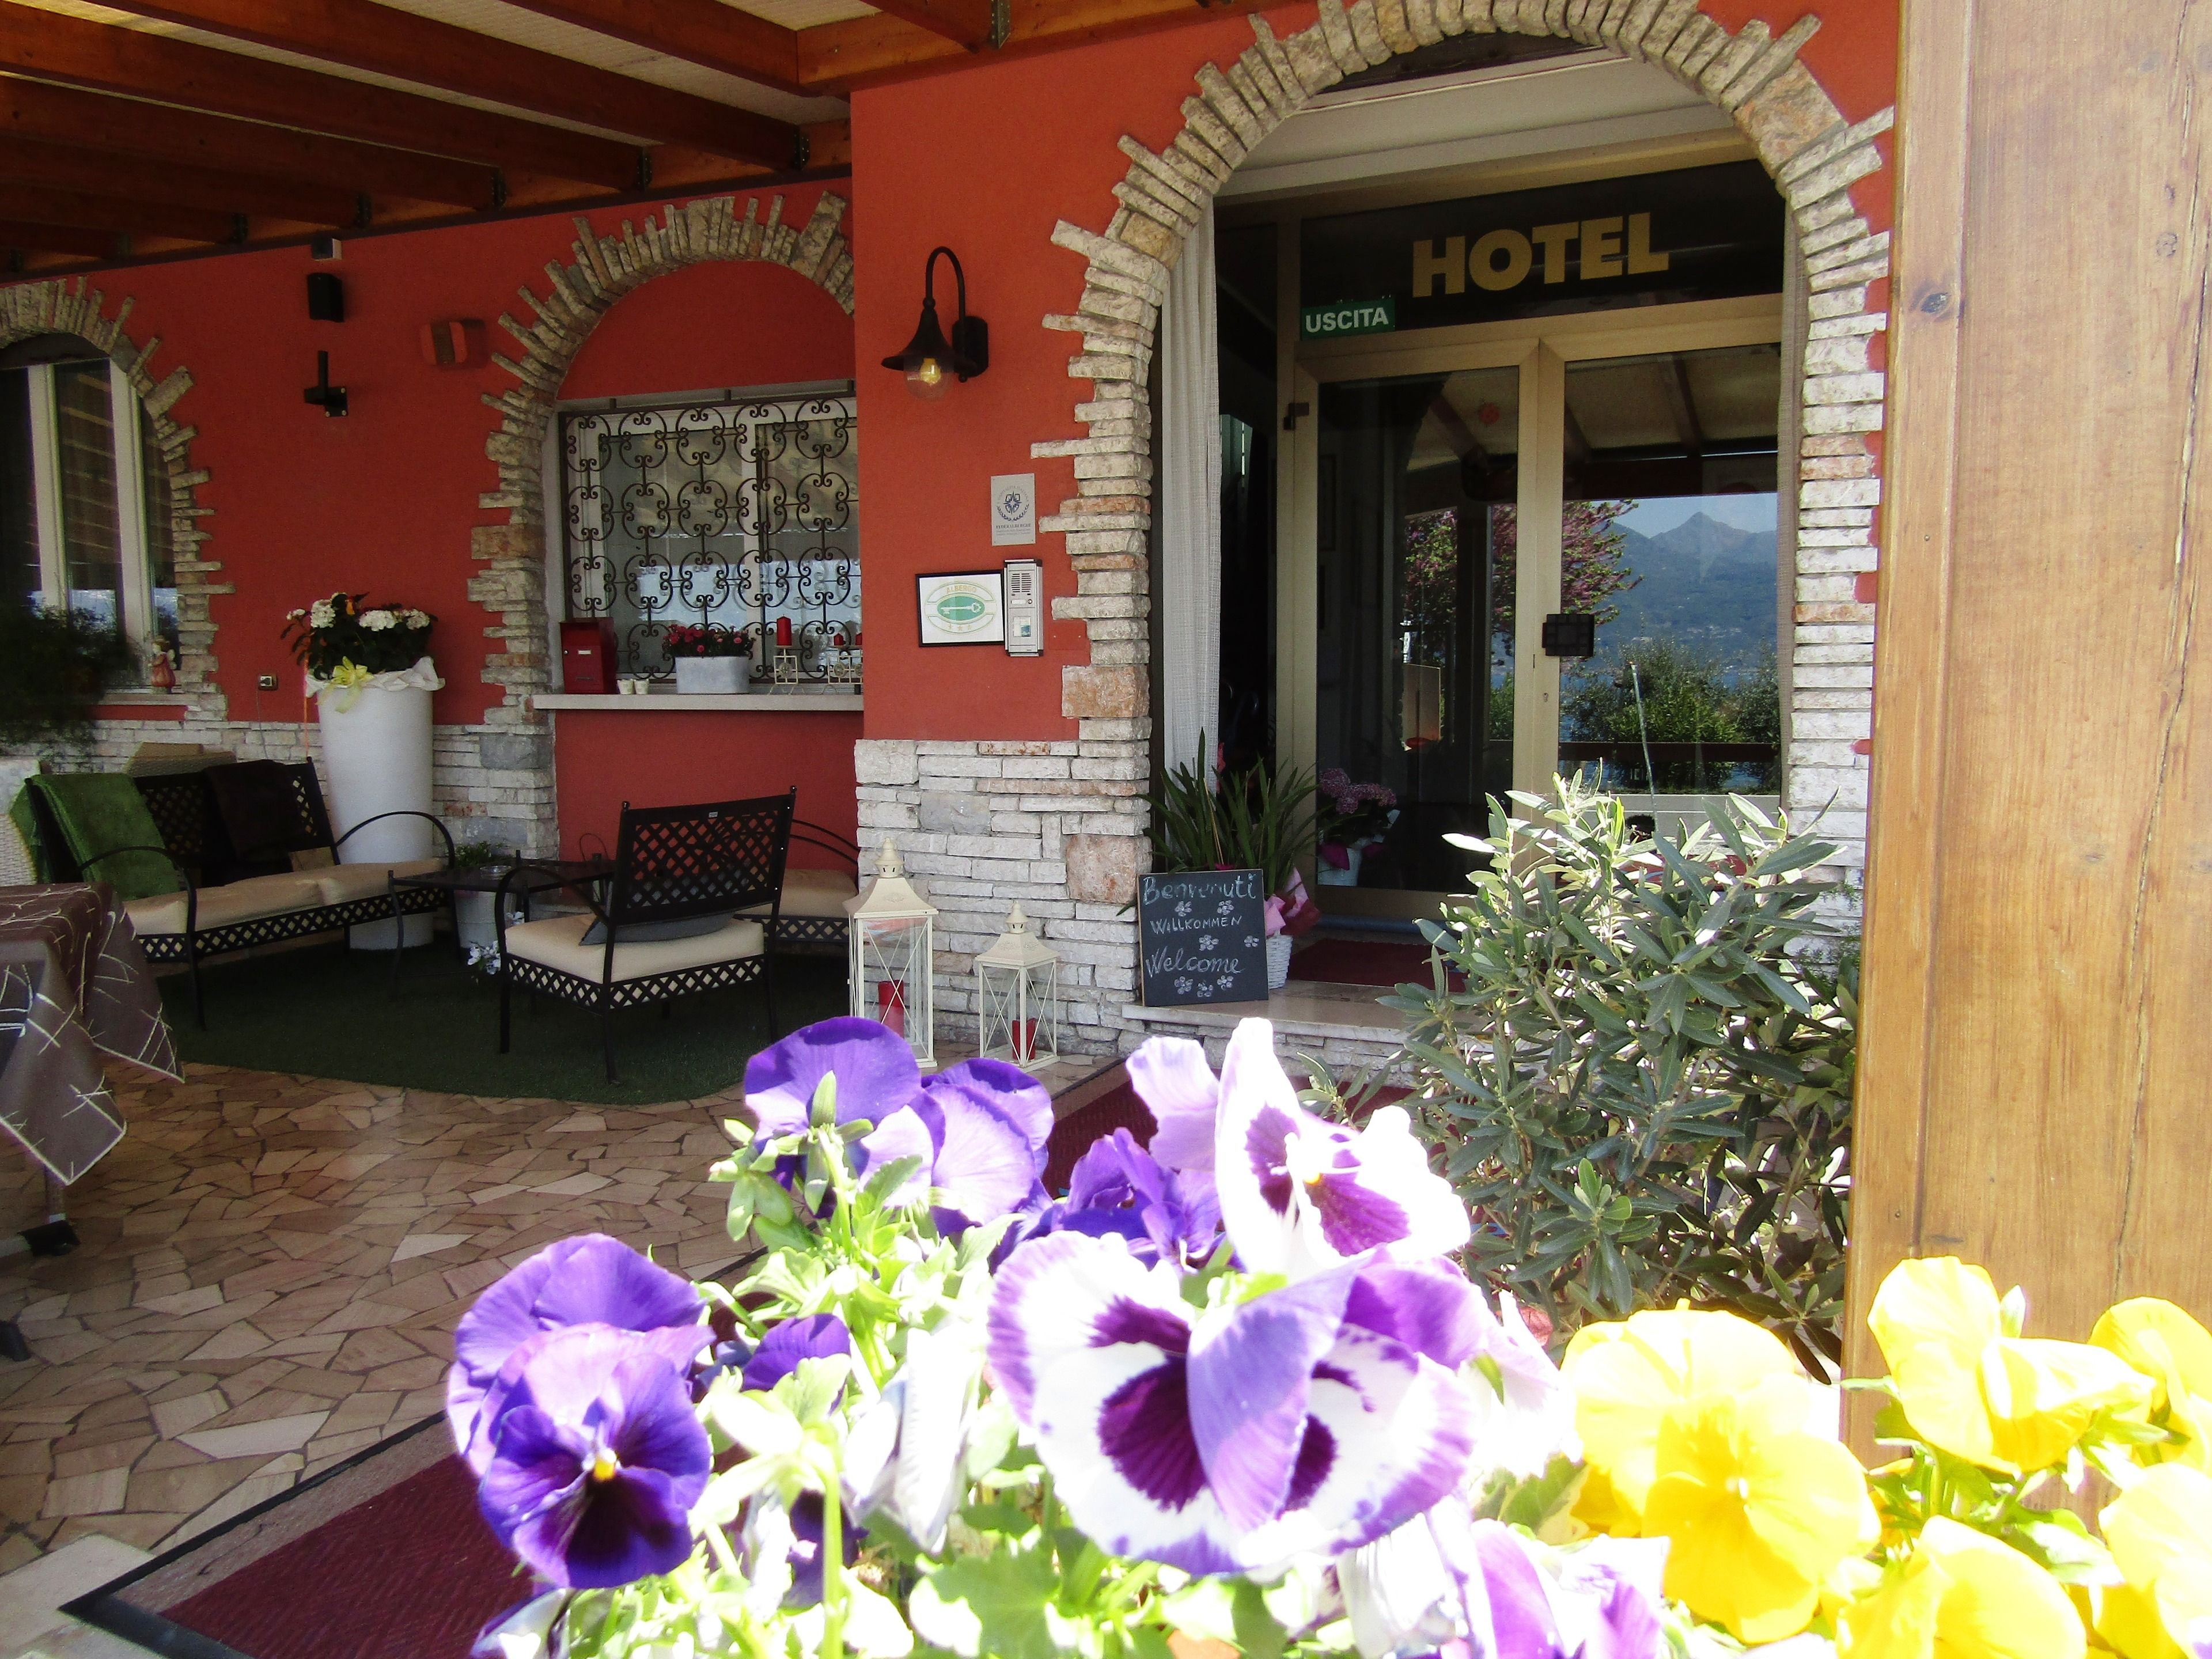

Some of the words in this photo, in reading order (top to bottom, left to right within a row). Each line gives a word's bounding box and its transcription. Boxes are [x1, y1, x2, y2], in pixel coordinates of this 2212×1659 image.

[1412, 212, 1669, 298] HOTEL
[1305, 307, 1389, 333] USCITA
[1143, 873, 1256, 905] Benvenuti
[1145, 946, 1246, 978] Welcome
